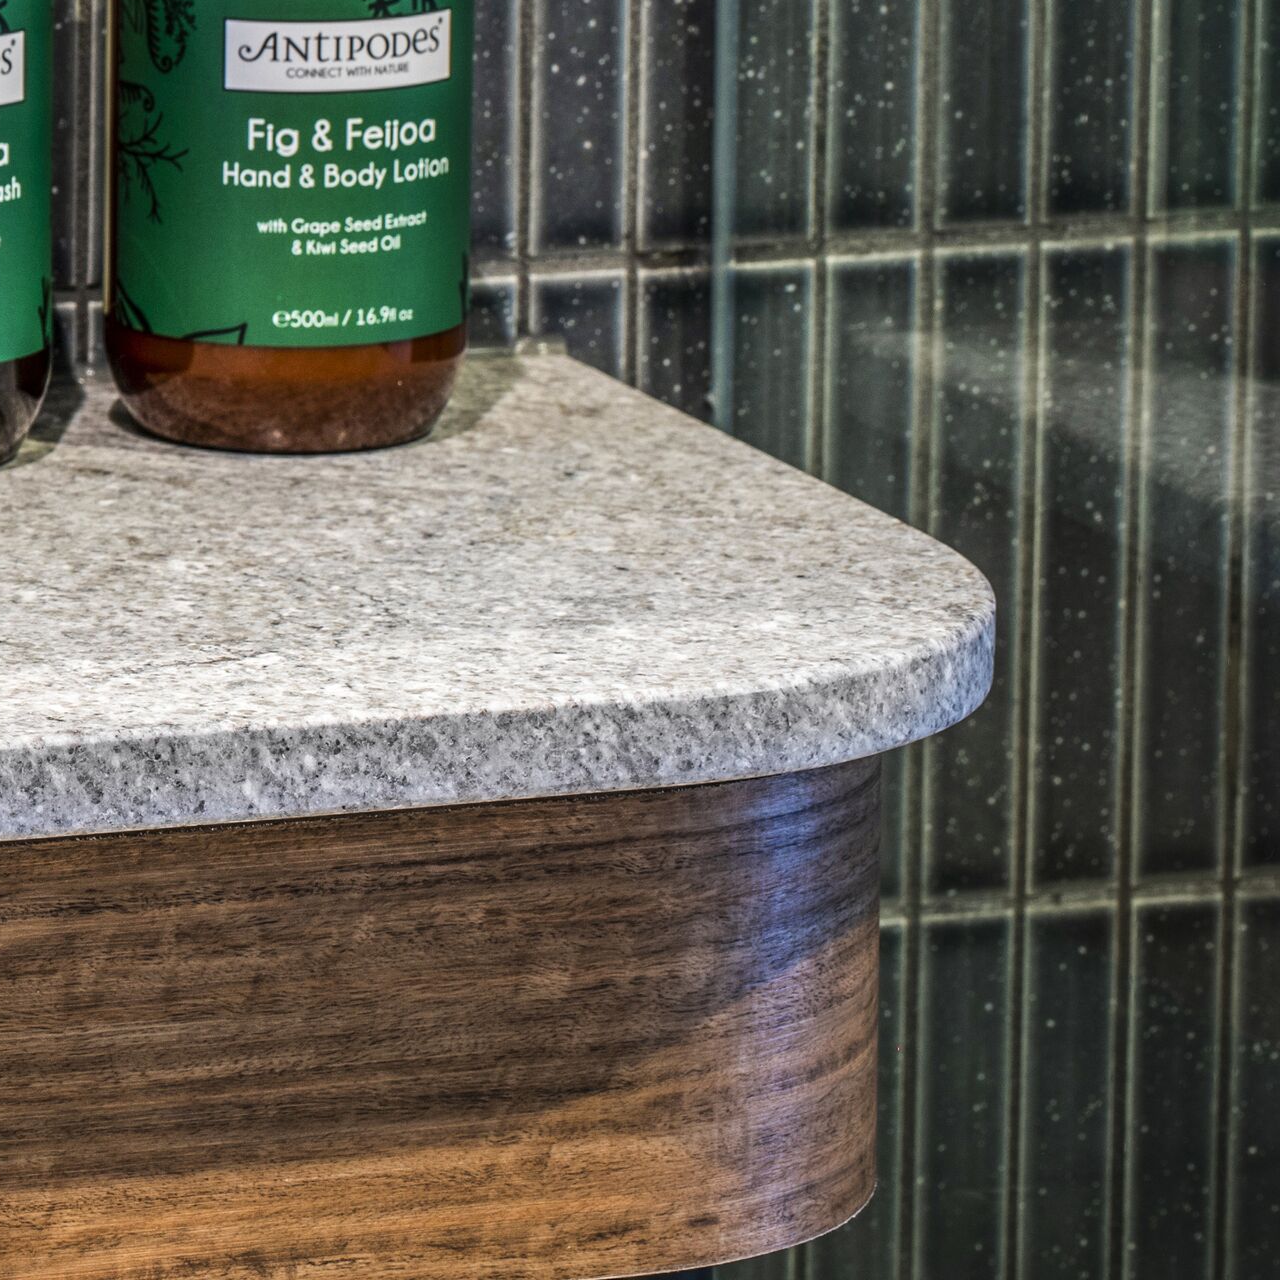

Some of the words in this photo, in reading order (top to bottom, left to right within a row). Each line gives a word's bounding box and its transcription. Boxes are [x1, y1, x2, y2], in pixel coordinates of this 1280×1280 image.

[286, 67, 342, 79] CONNECT
[345, 66, 371, 77] WITH
[374, 62, 409, 75] NATURE
[247, 118, 300, 157] Fig
[311, 119, 333, 152] &
[345, 117, 437, 152] Feijoa
[222, 160, 291, 189] Hand
[298, 163, 316, 189] &
[324, 161, 387, 190] Body
[393, 156, 450, 184] Lotion
[256, 218, 288, 234] with
[291, 218, 341, 237] Grape
[344, 216, 383, 233] Seed
[384, 210, 427, 230] Extract
[291, 239, 302, 255] &
[306, 240, 337, 255] Kiwi
[340, 237, 378, 254] Seed
[381, 234, 401, 251] Oil
[342, 309, 352, 327] /
